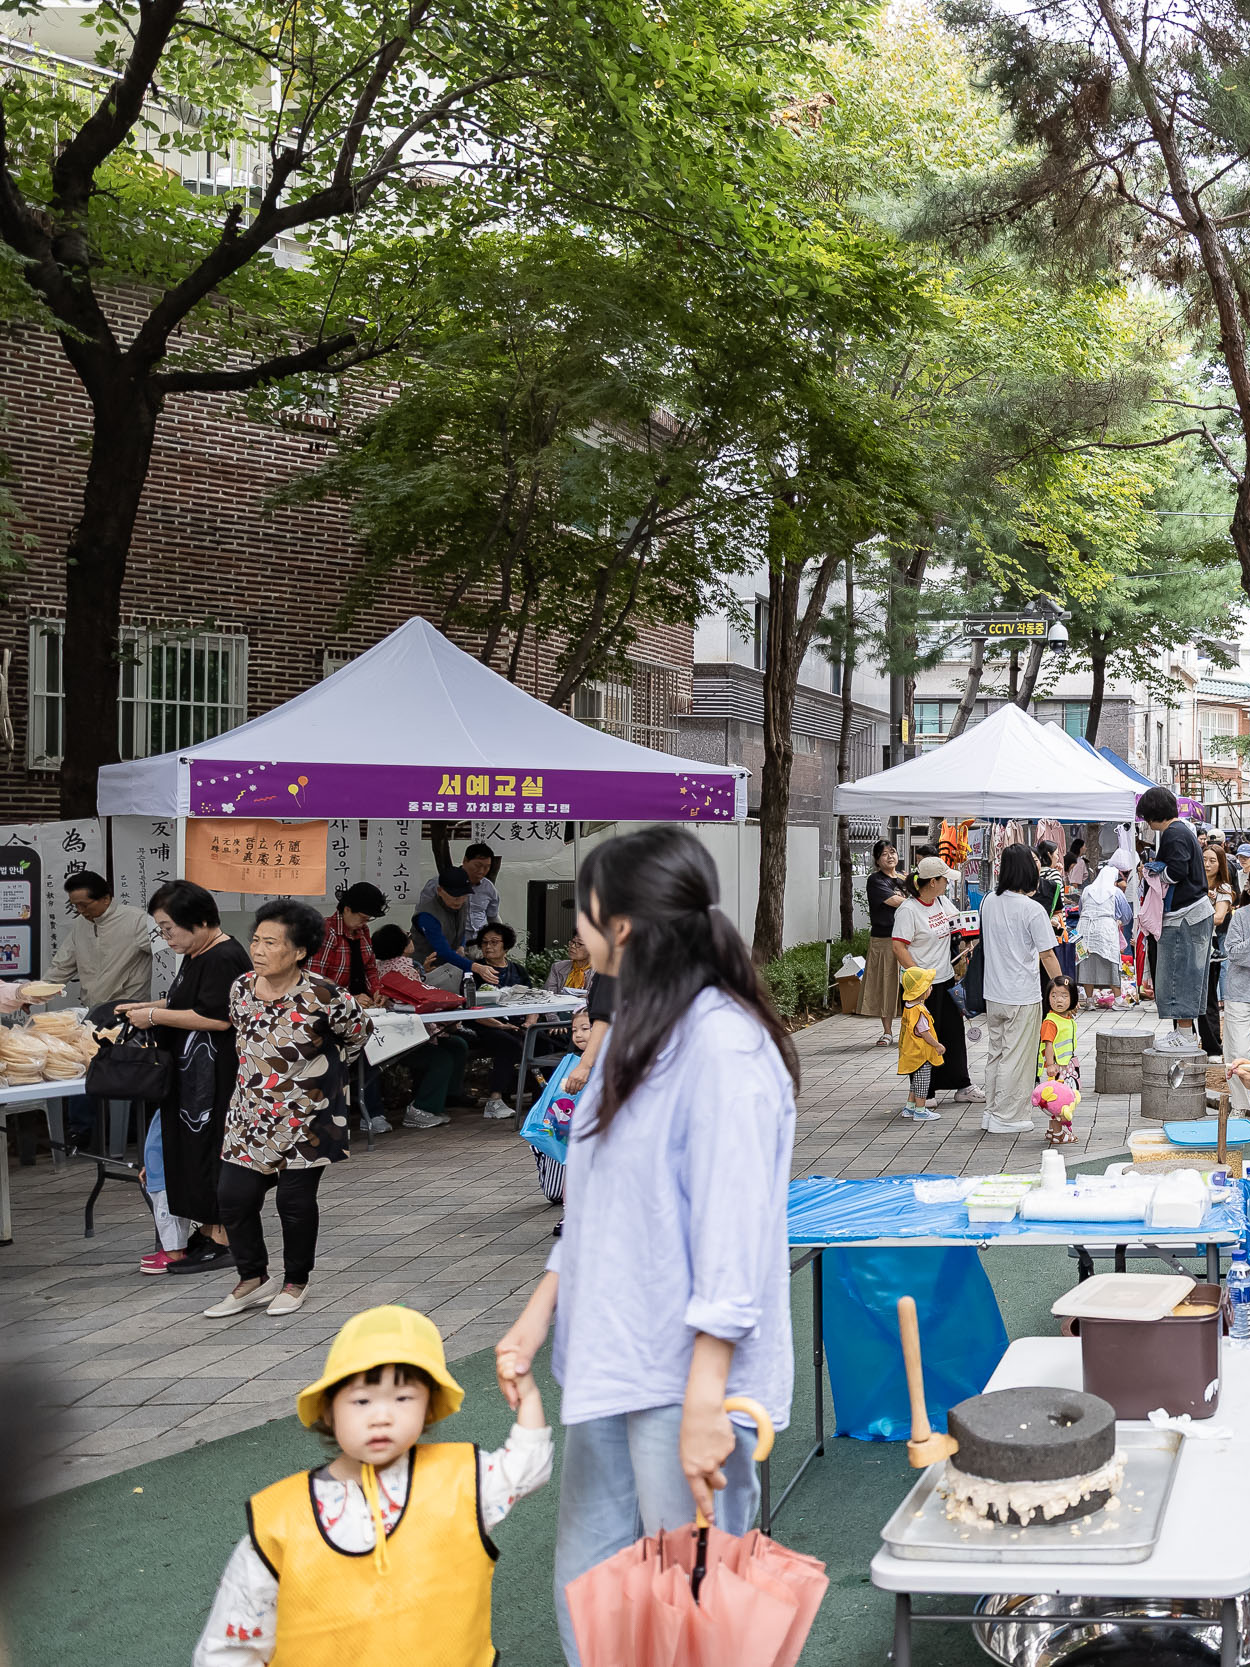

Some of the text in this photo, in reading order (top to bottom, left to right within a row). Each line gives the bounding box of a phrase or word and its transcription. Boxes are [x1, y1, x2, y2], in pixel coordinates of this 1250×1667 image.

[989, 623, 1044, 635] CCTV 작동중
[437, 774, 543, 797] 서예교실
[408, 801, 570, 814] 중곡2동 자치회관 프로그램
[393, 820, 411, 899] 믿음소망
[9, 866, 24, 875] 안내
